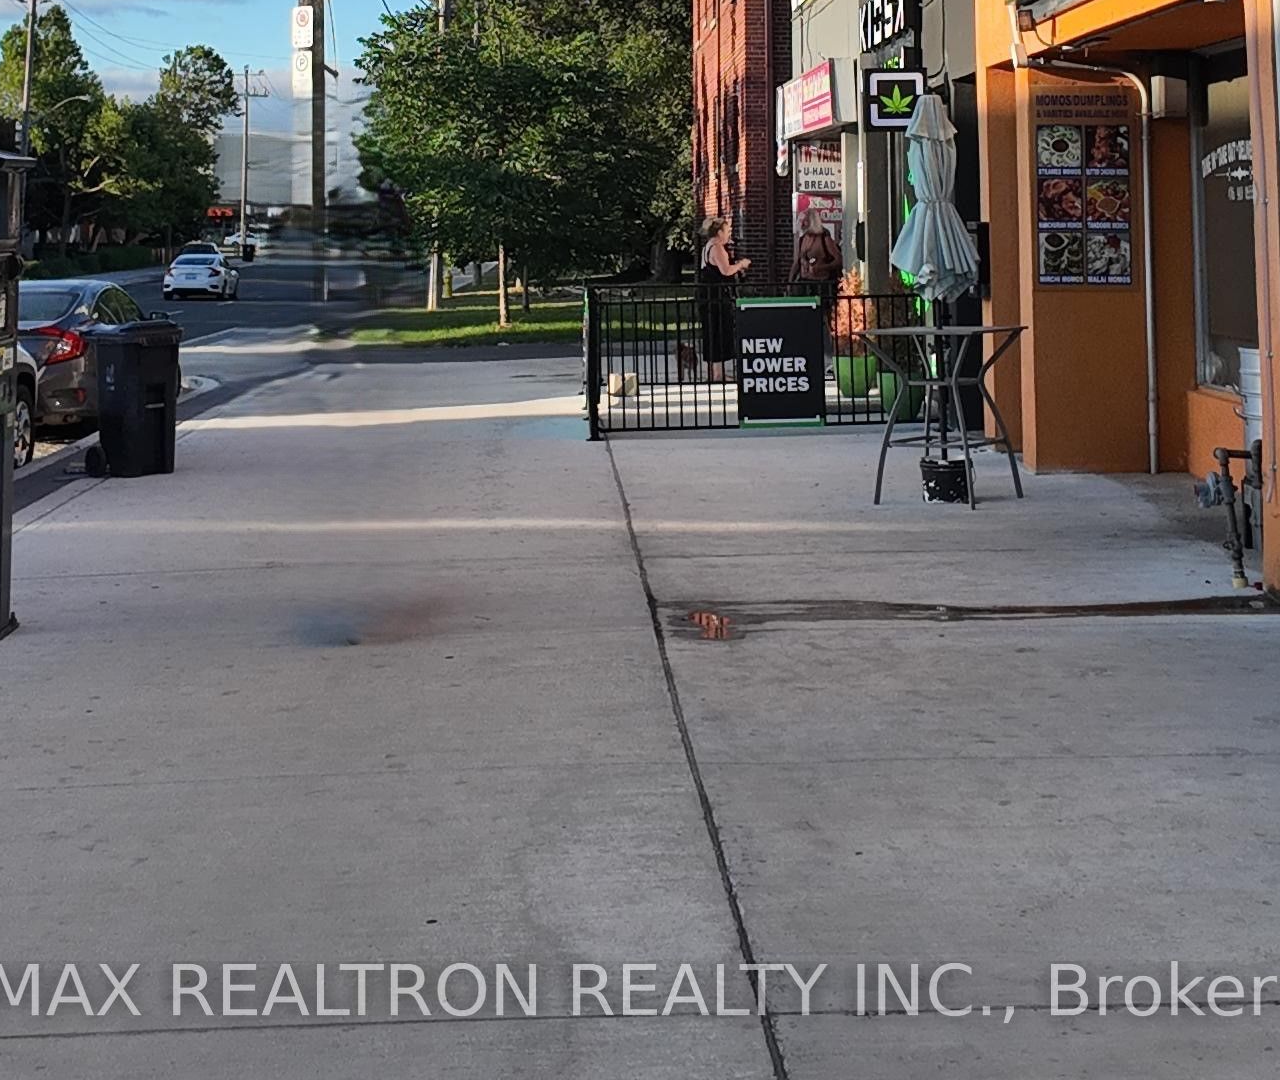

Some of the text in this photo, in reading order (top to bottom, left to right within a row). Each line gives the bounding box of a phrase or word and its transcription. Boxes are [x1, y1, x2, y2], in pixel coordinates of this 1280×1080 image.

[804, 180, 836, 190] BREAD
[741, 337, 783, 354] NEW
[742, 357, 807, 373] LOWER
[743, 376, 810, 393] PRICES
